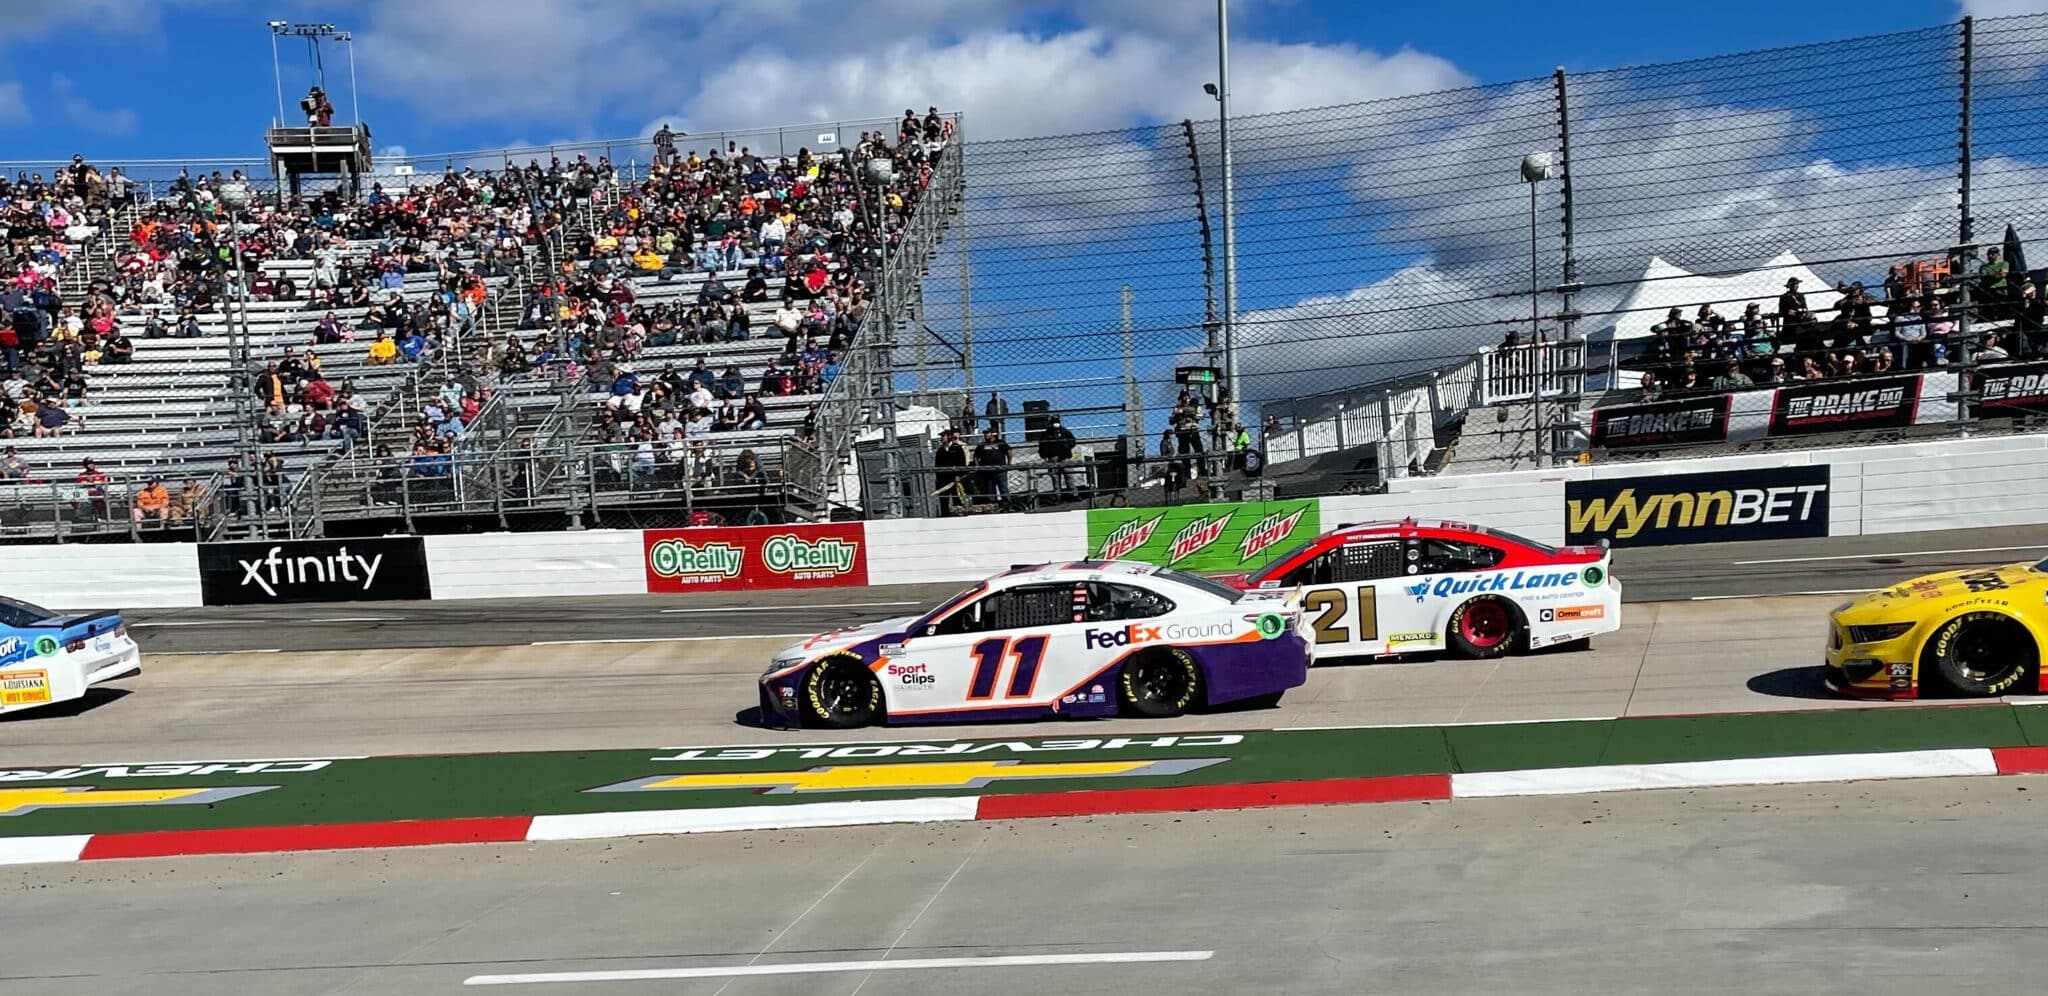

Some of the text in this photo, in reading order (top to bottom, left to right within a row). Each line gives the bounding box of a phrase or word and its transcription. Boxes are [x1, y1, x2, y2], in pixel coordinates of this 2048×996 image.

[1984, 381, 2006, 396] THE
[1788, 399, 1810, 415] THE
[1811, 389, 1880, 417] BRAKE
[1607, 421, 1627, 435] THE
[1628, 411, 1693, 436] BRAKE
[654, 542, 741, 573] O'Reilly
[766, 538, 853, 571] O'Reilly
[239, 546, 383, 597] xfinity
[681, 574, 722, 584] AUTO PARTS
[793, 570, 835, 580] AUTO PARTS
[1433, 570, 1578, 598] Quick Lane
[1304, 585, 1378, 645] 21
[1558, 608, 1601, 618] Omnicraft
[1085, 619, 1233, 650] FedEx Ground
[888, 663, 927, 676] Sport
[902, 674, 935, 685] Clips
[966, 633, 1052, 700] 11
[1988, 666, 2024, 694] EAGLE
[4, 679, 45, 690] LOUISIANA
[650, 734, 1245, 761] CHEVROLET
